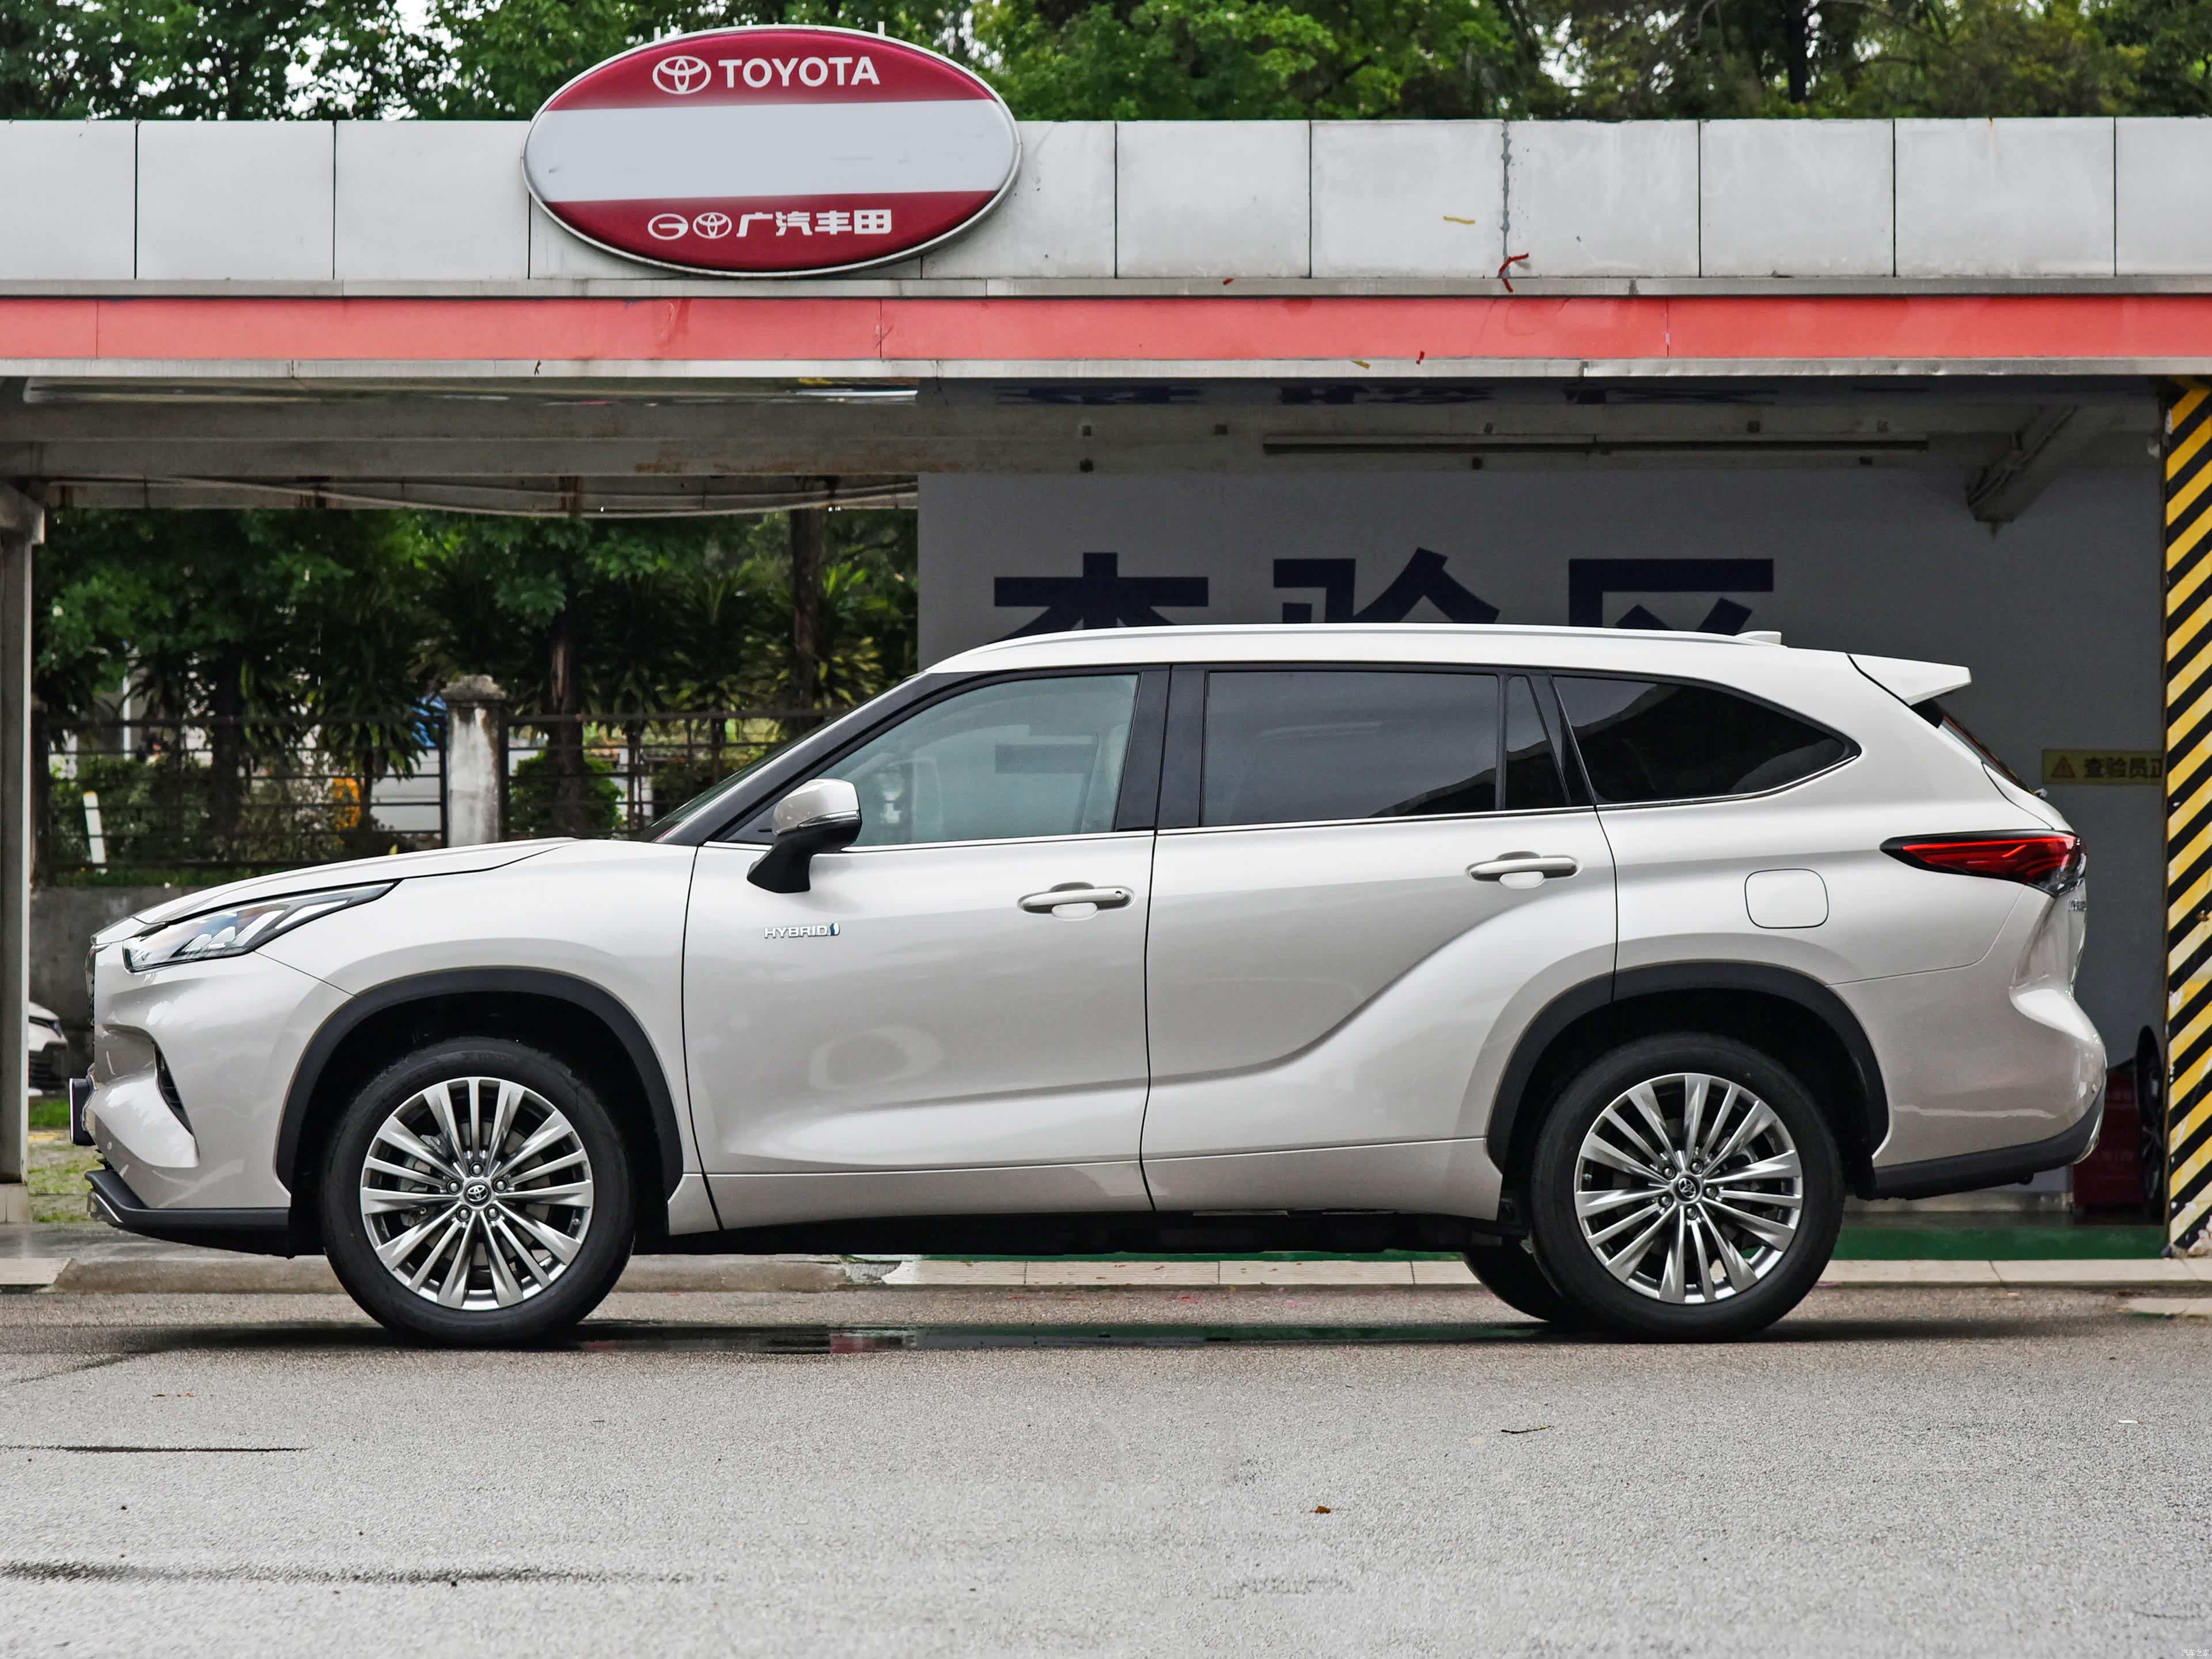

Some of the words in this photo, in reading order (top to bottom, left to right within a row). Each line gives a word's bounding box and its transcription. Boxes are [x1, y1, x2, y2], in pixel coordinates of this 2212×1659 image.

[719, 56, 881, 88] TOYOTA
[737, 209, 892, 237] 广汽丰田
[764, 925, 830, 938] HYBRID
